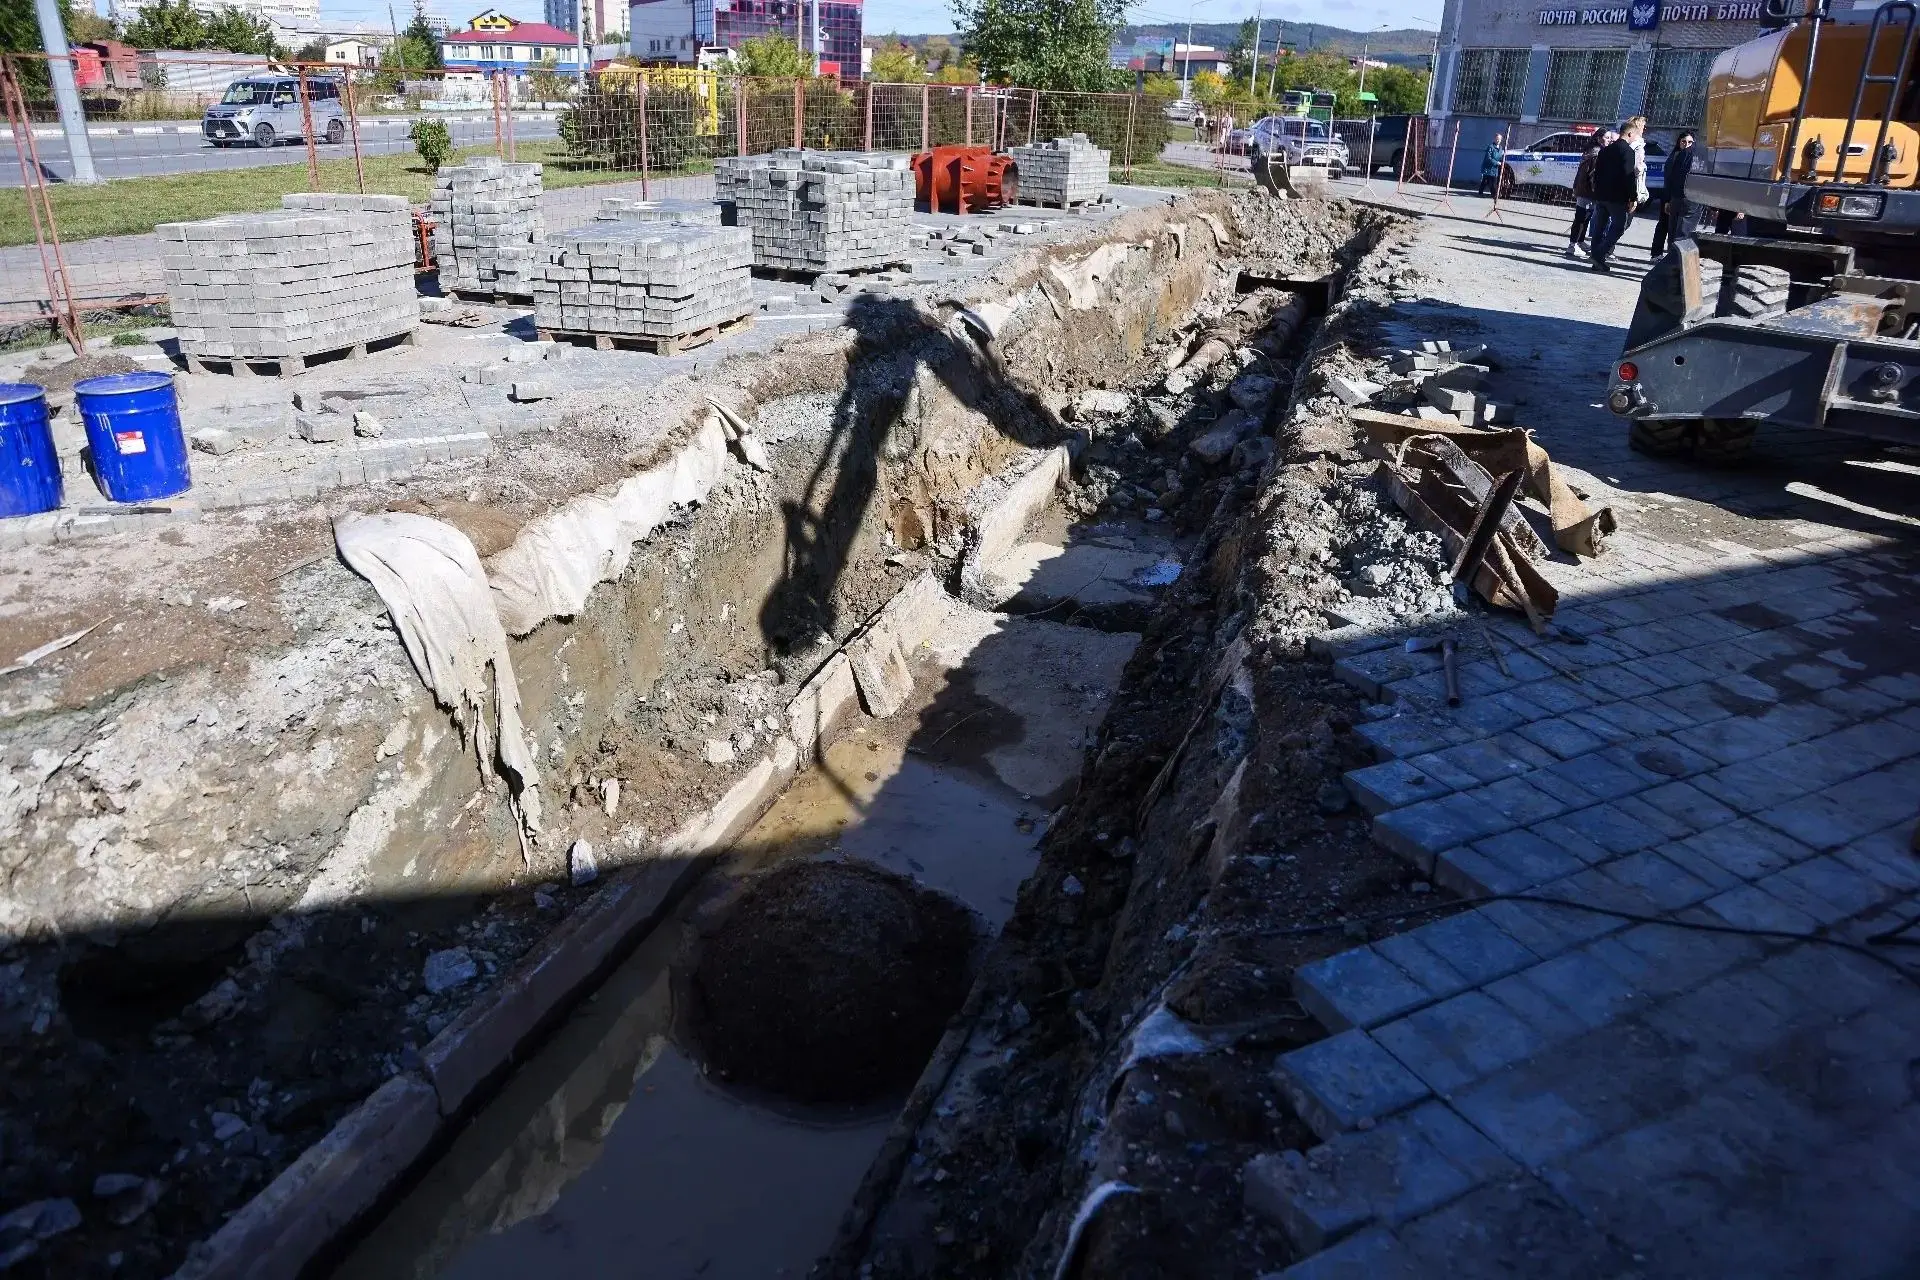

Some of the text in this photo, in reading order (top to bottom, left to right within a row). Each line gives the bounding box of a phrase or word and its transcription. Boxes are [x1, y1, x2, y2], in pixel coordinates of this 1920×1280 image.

[1539, 8, 1628, 25] ПОЧТА РОССИИ
[1661, 2, 1762, 21] ПОЧТА БАНК
